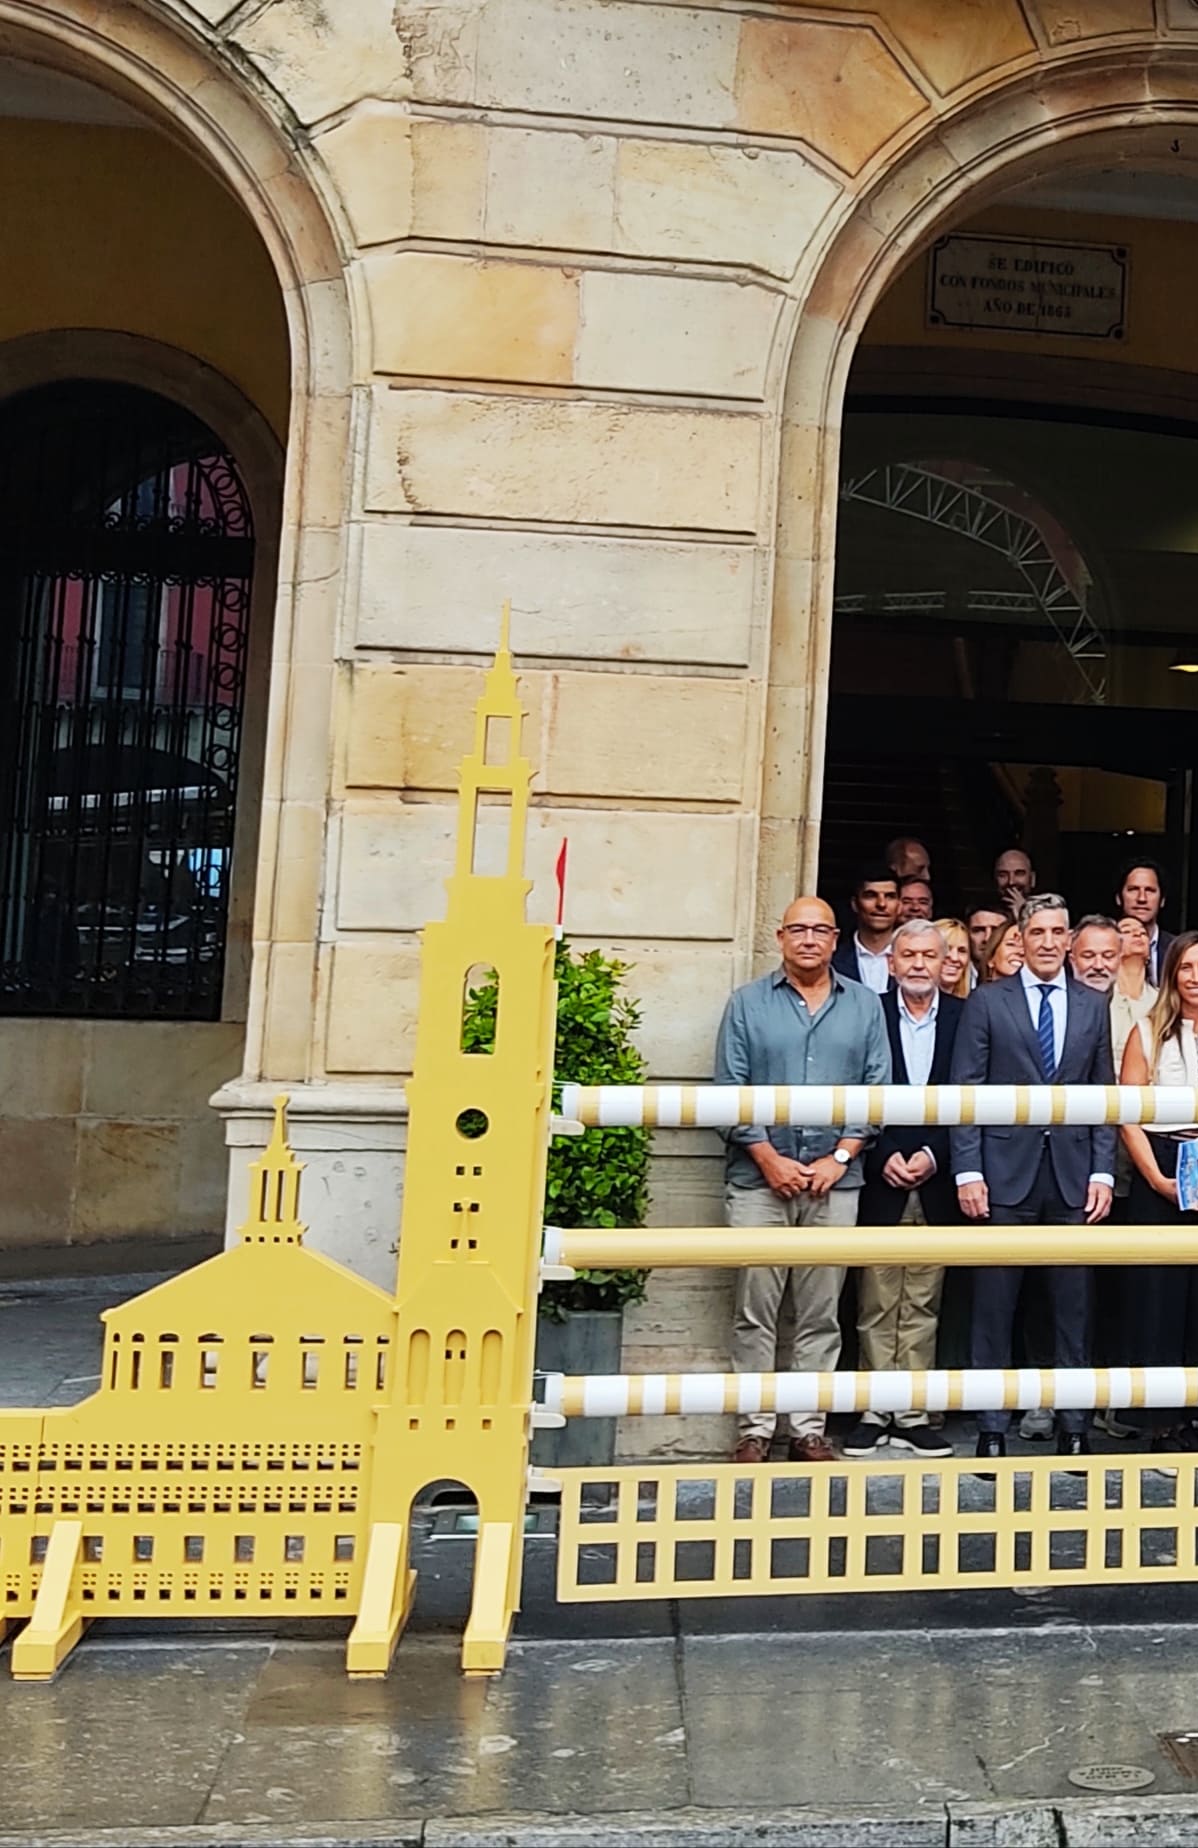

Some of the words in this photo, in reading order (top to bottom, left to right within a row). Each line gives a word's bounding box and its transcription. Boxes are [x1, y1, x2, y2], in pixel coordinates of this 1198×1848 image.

[987, 256, 1007, 270] SE
[940, 274, 967, 289] CON
[971, 276, 1025, 292] FONDOS
[983, 296, 1013, 313] AÑO
[1016, 302, 1035, 316] DE
